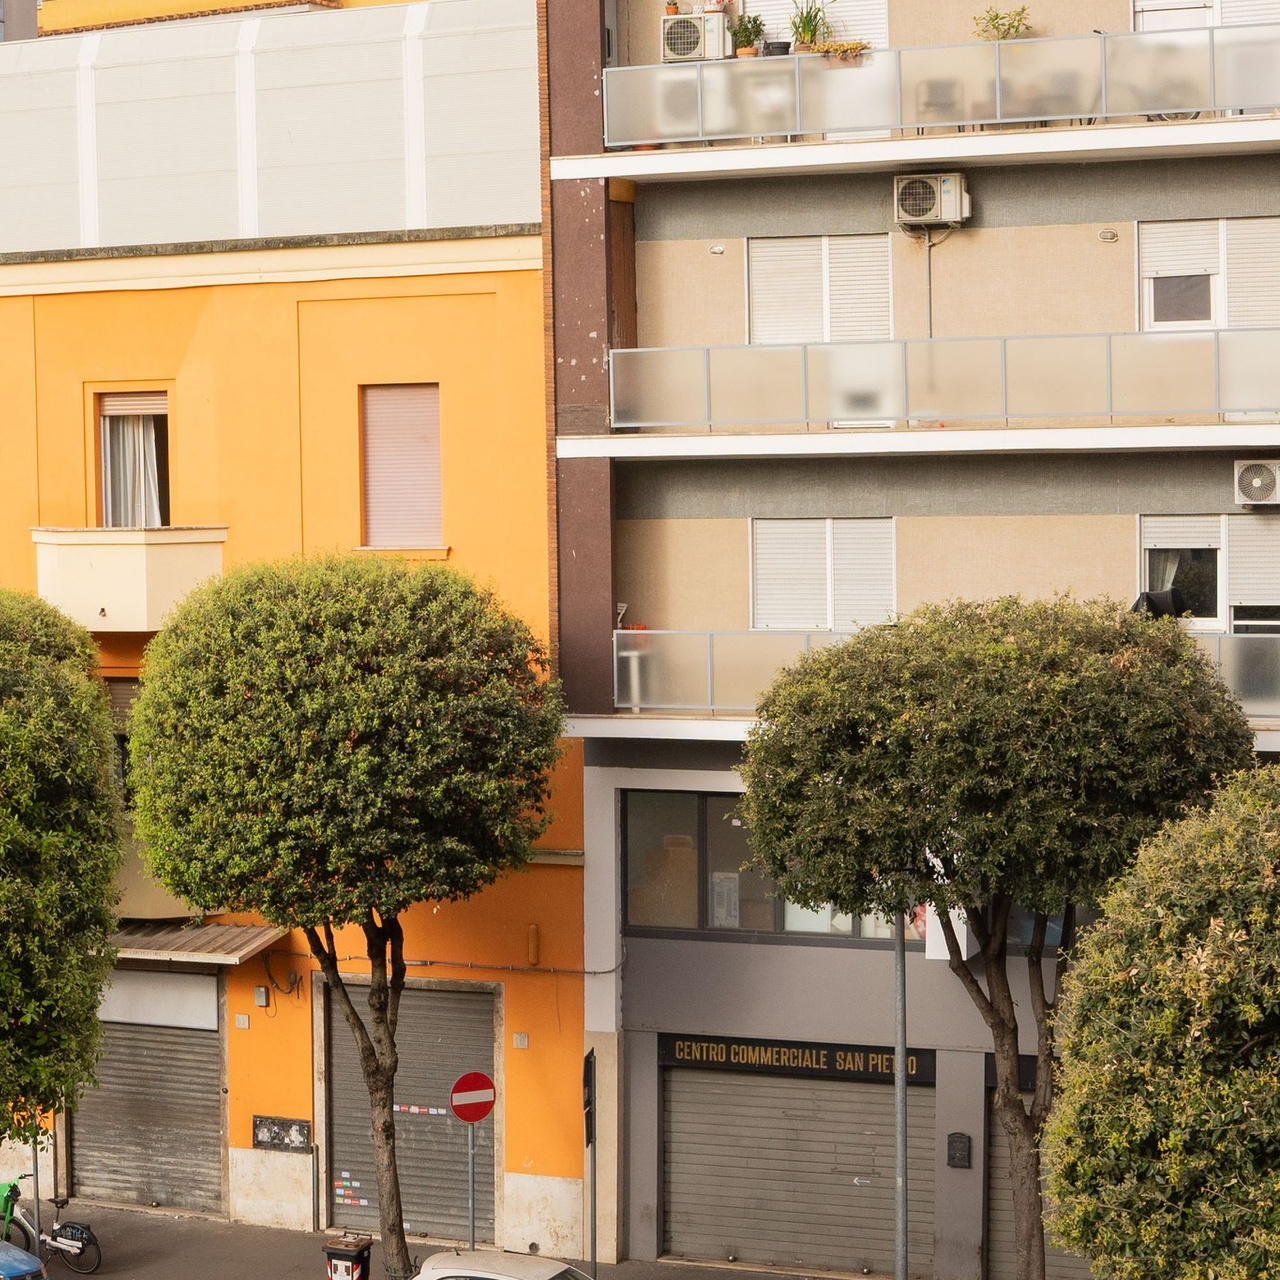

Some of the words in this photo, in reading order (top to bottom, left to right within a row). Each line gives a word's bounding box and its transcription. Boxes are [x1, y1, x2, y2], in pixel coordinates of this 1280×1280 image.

[675, 1040, 726, 1062] CENTRO
[730, 1044, 828, 1069] COMMERCIALE
[836, 1051, 864, 1071] SAN
[868, 1053, 917, 1075] PIETO
